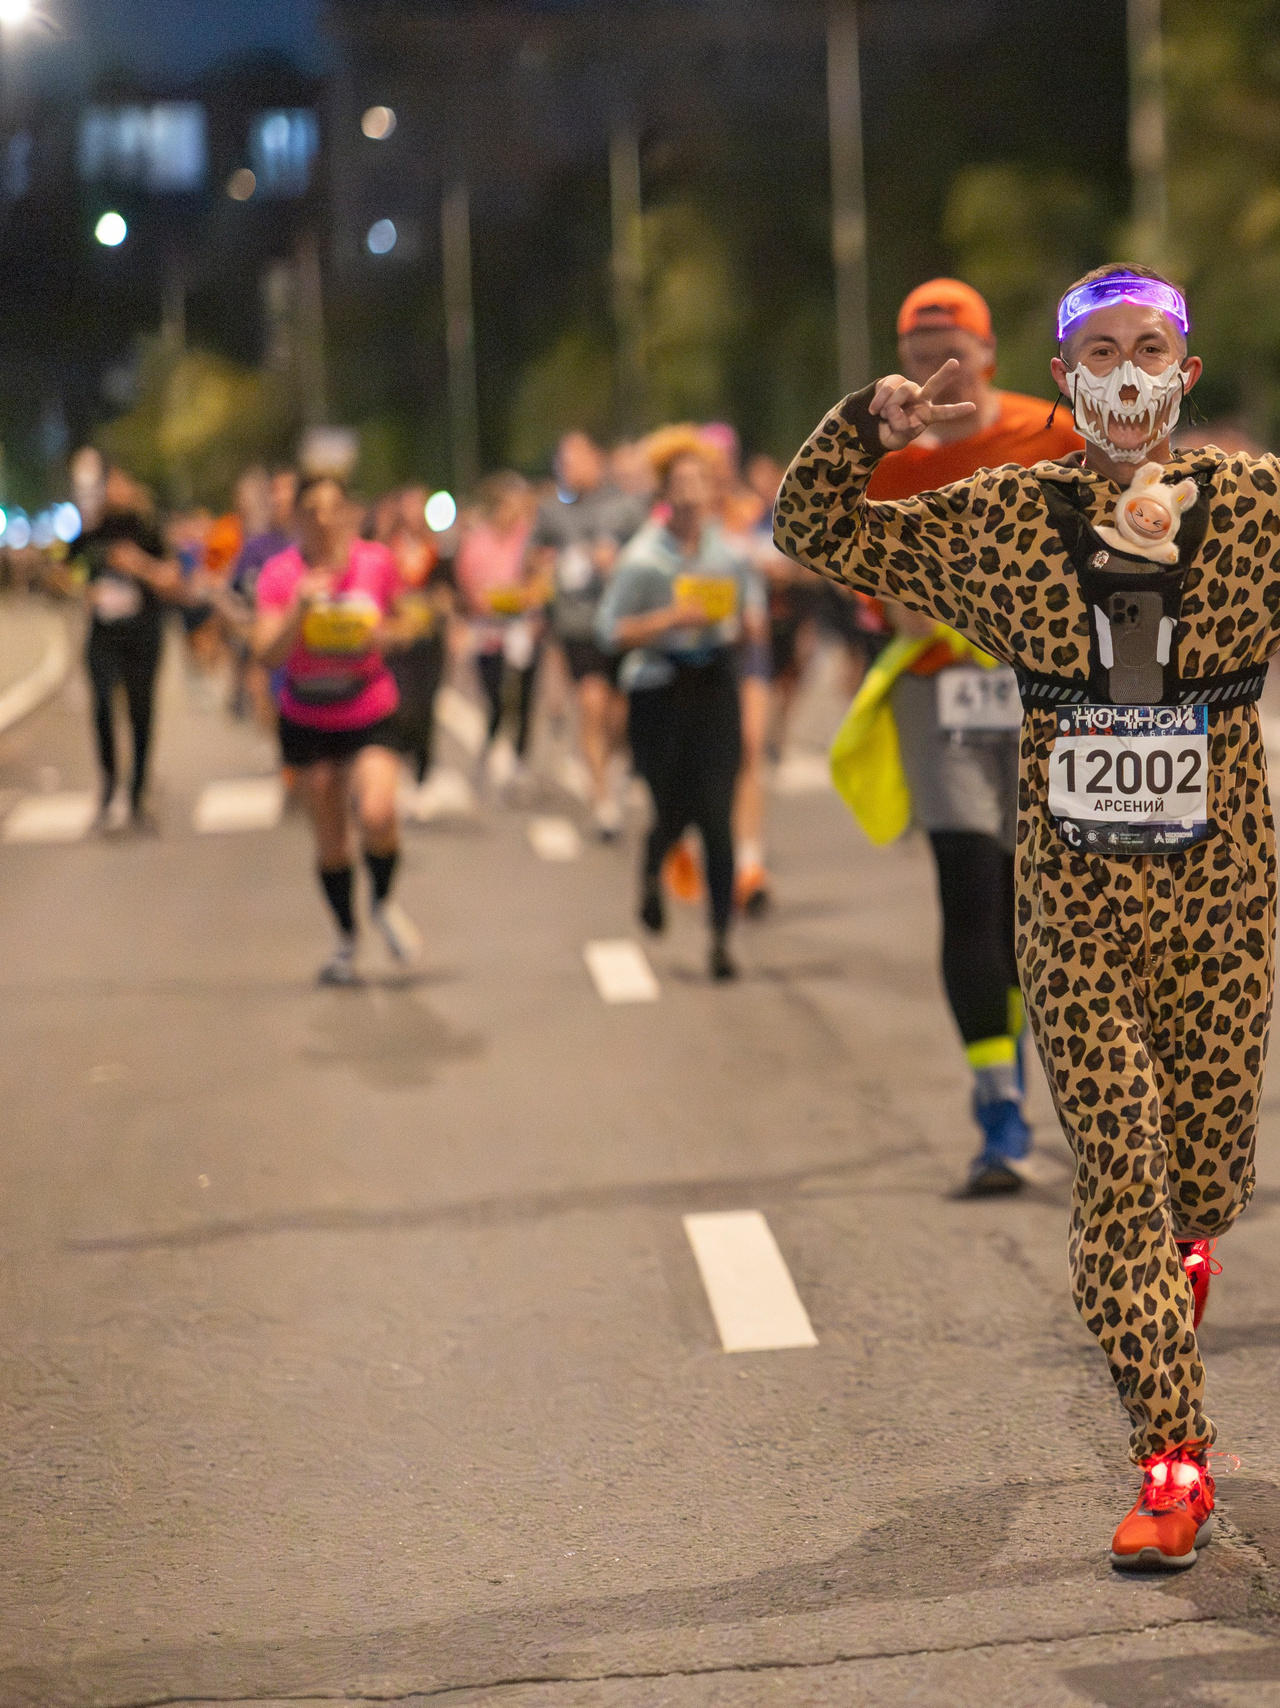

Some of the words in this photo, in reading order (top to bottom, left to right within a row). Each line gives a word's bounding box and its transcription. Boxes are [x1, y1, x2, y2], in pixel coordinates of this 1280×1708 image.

[1072, 705, 1196, 730] НОЧНОЙ
[1058, 749, 1202, 795] 12002
[1094, 797, 1164, 812] АРСЕНИЙ
